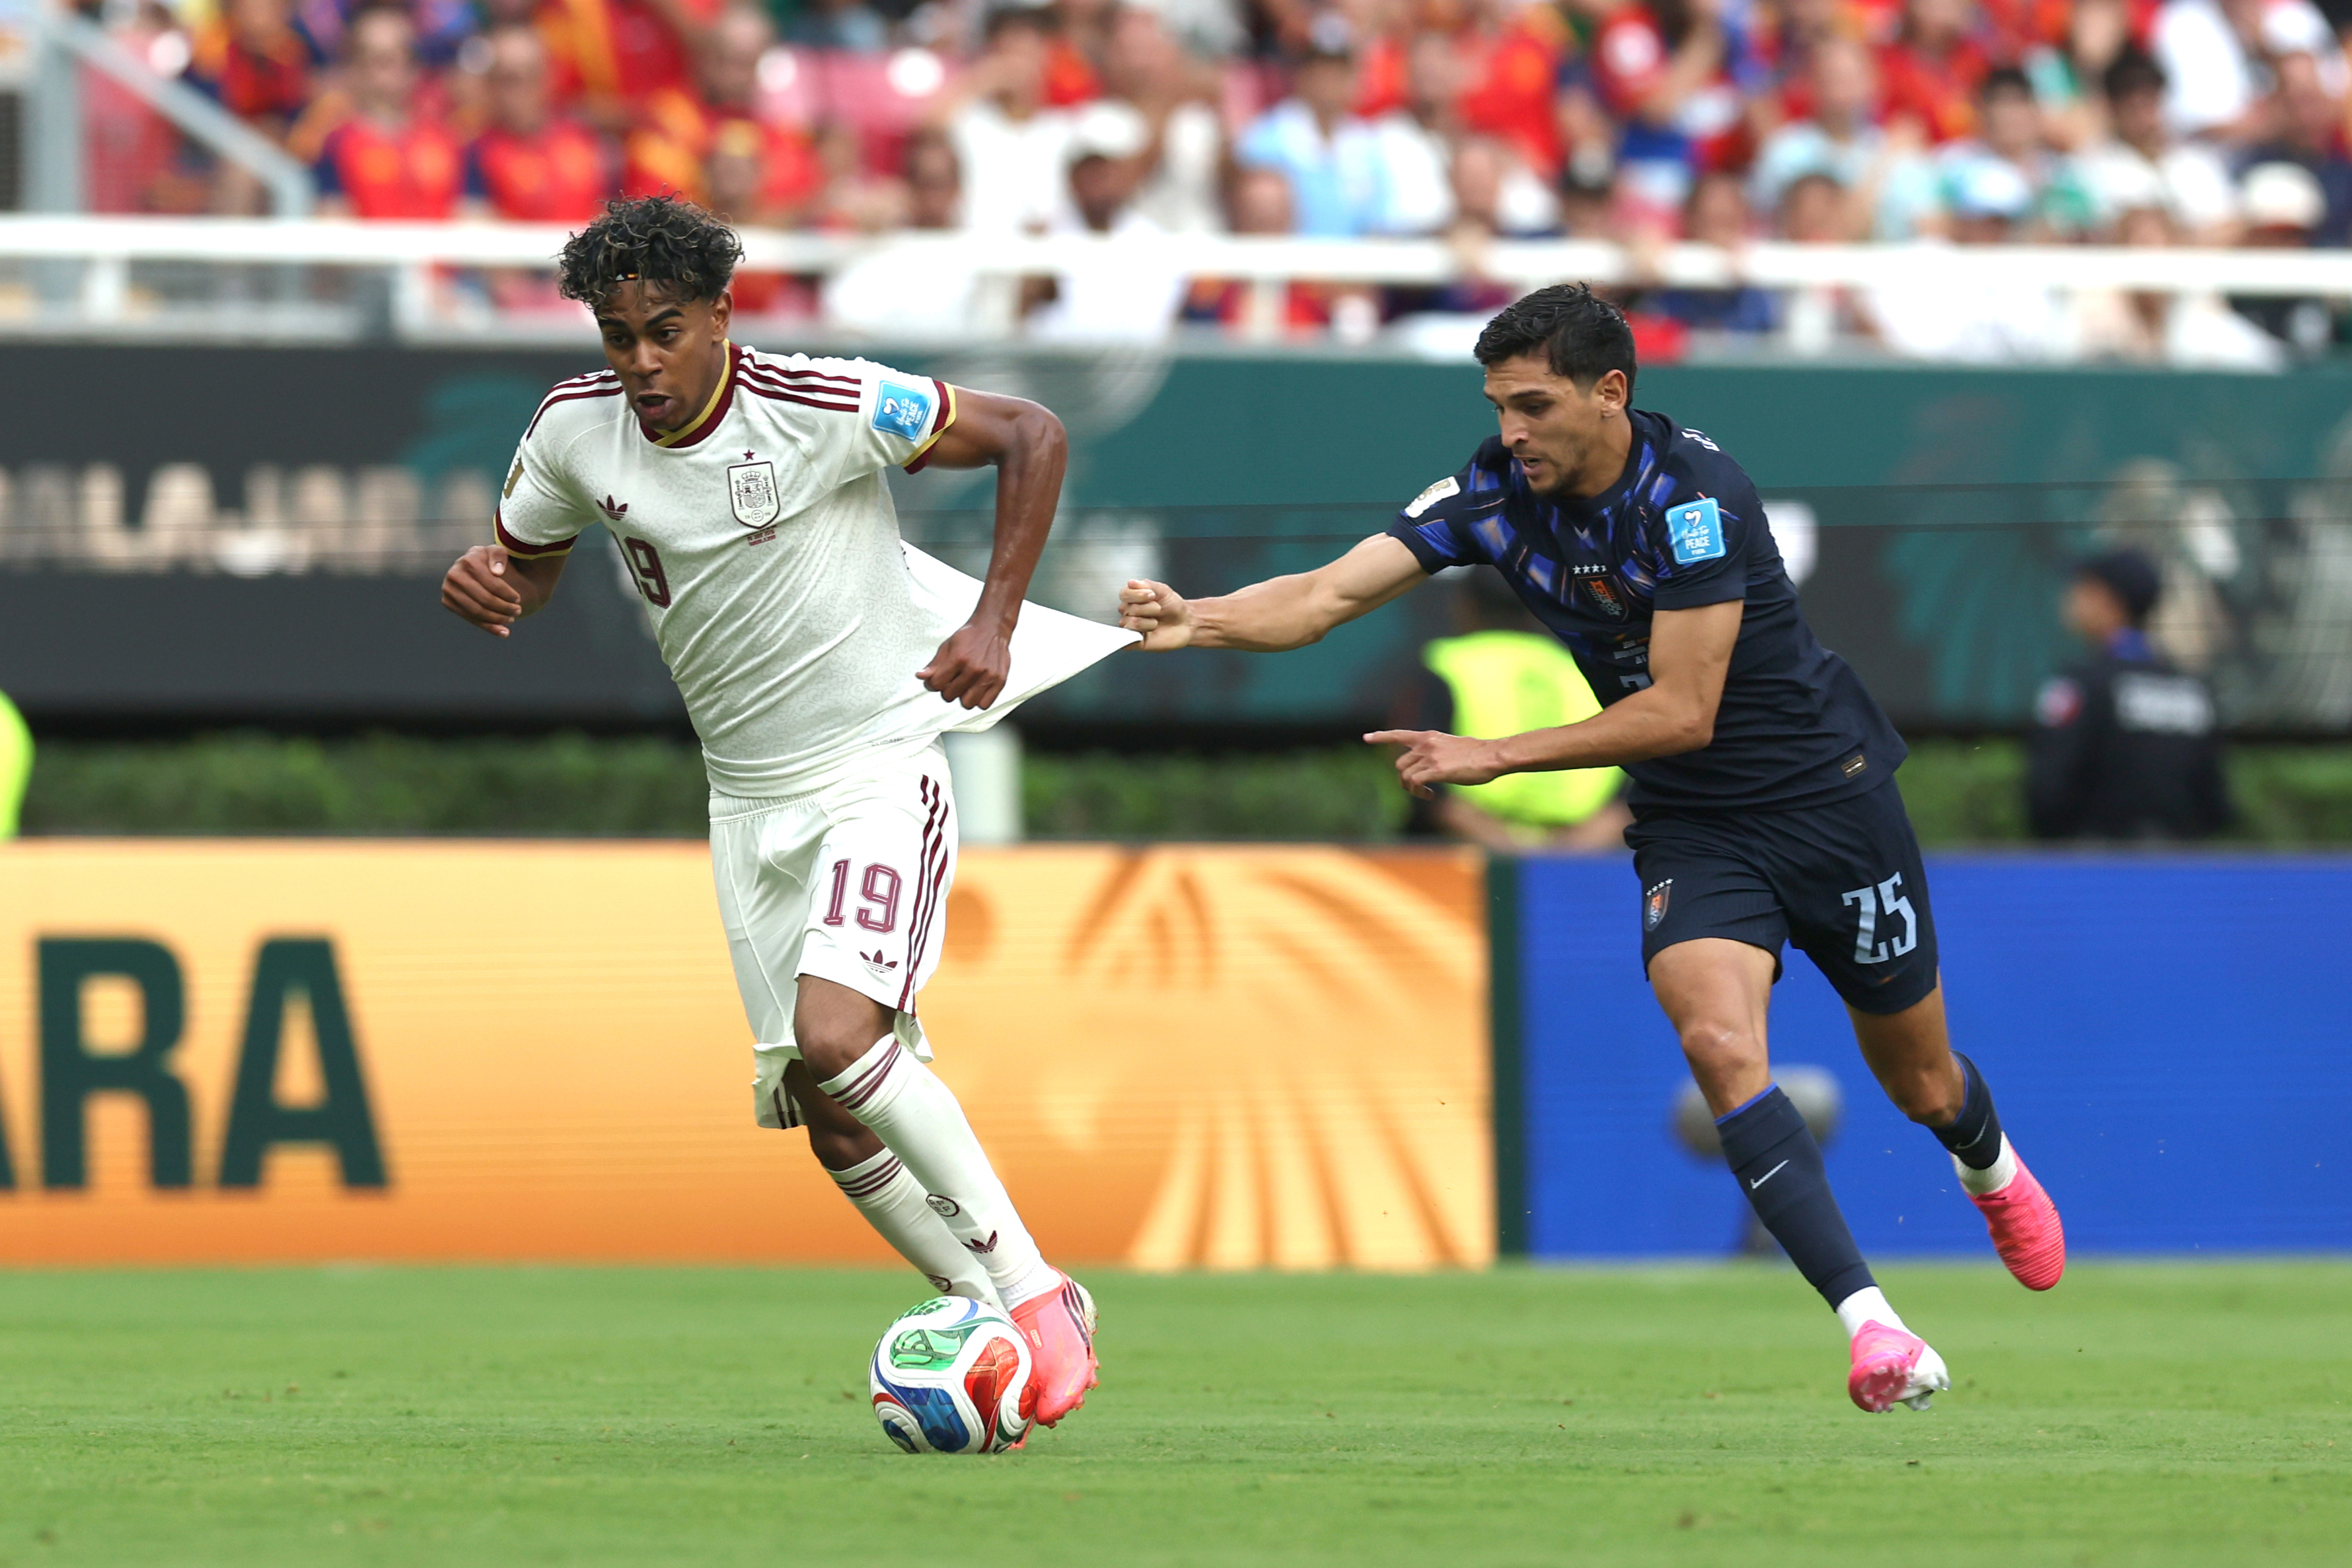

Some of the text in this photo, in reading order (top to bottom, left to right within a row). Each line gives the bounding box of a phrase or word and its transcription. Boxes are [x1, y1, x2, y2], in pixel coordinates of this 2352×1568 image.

[904, 401, 920, 426] PEACE
[1685, 536, 1710, 550] PEACE
[822, 858, 903, 935] 19
[1841, 871, 1917, 964] 25
[0, 937, 391, 1189] RA
